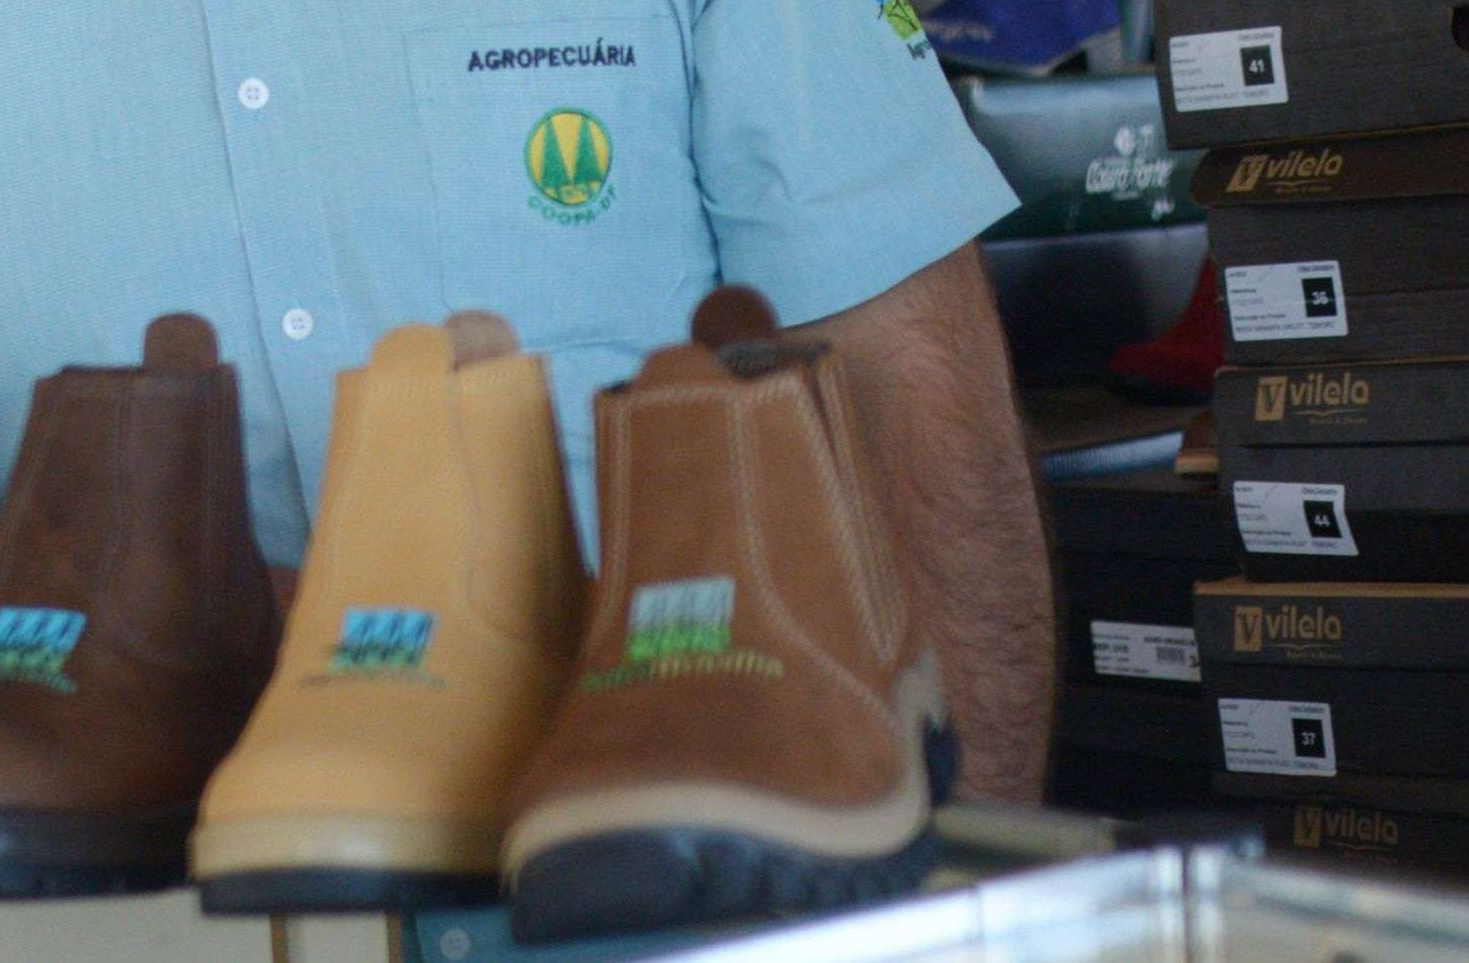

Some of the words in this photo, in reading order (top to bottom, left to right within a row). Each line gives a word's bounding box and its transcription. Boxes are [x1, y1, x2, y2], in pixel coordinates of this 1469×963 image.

[468, 37, 636, 72] AGROPECUÁRIA
[1249, 59, 1265, 74] 41
[1290, 372, 1370, 407] vilela
[1314, 514, 1331, 526] 44
[1265, 605, 1343, 640] vilela
[1301, 731, 1317, 746] 37
